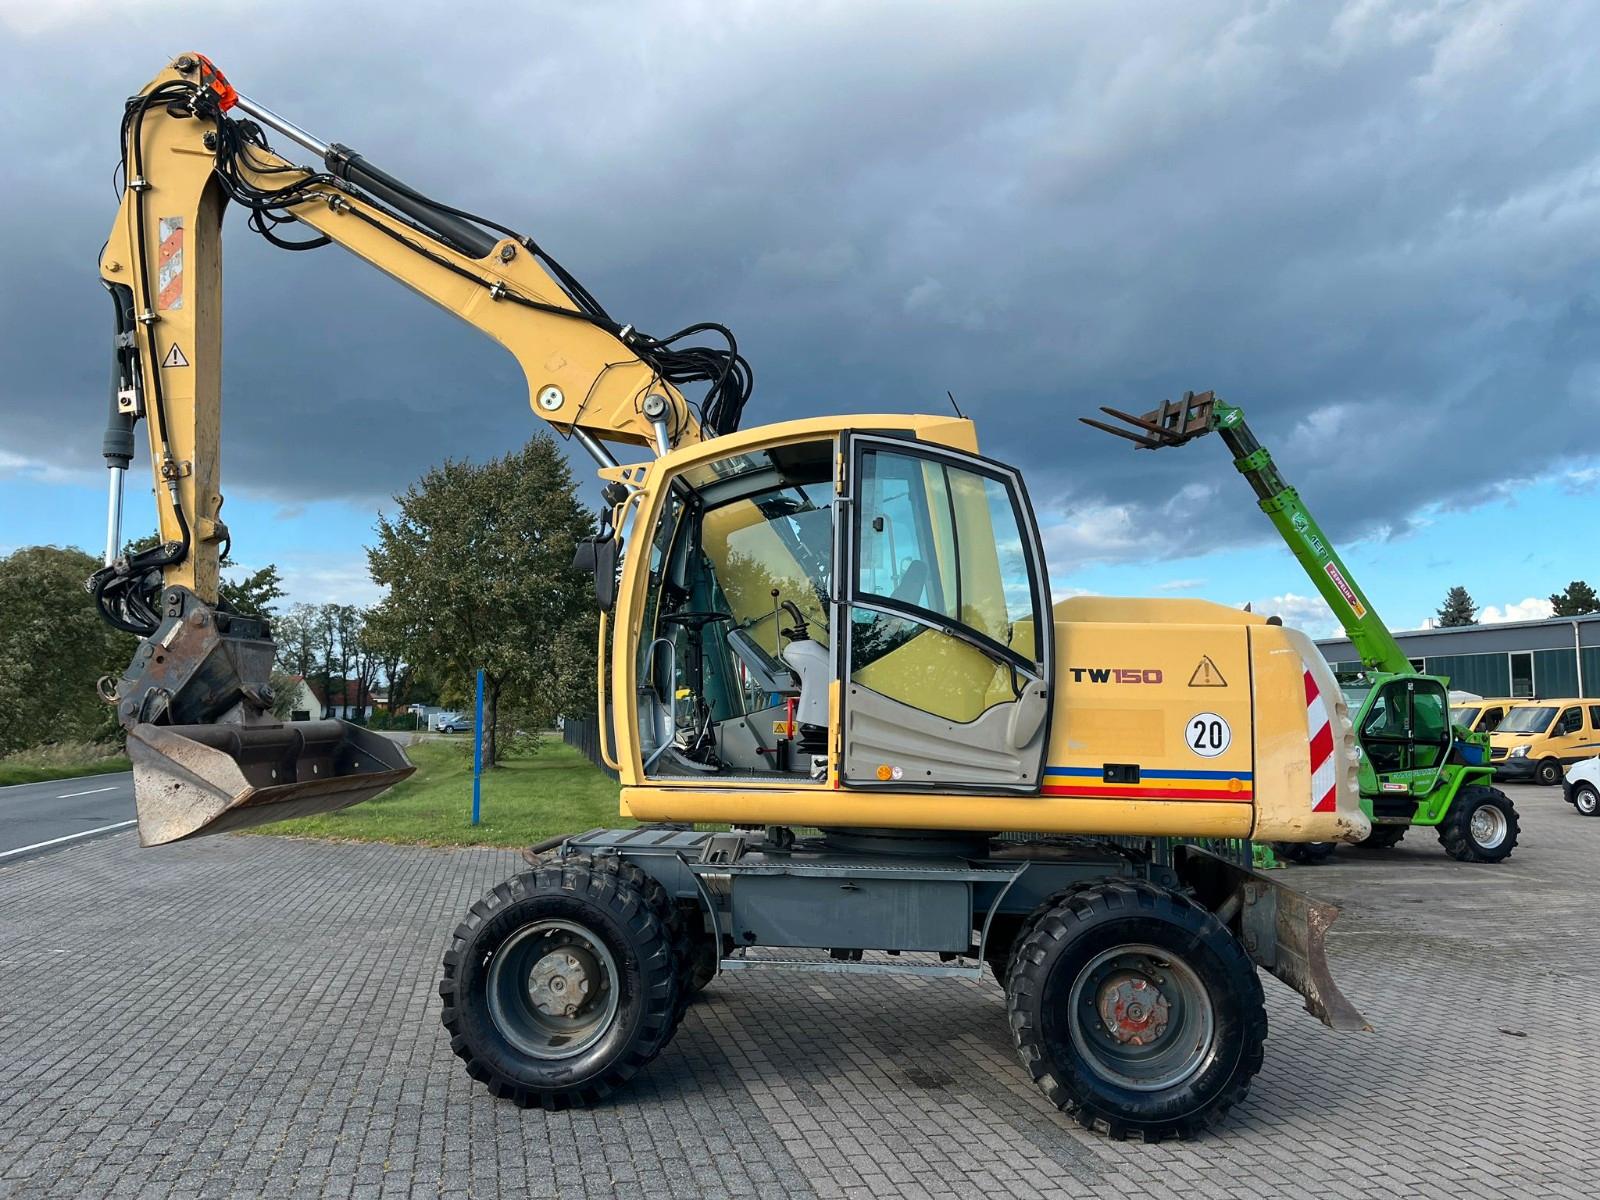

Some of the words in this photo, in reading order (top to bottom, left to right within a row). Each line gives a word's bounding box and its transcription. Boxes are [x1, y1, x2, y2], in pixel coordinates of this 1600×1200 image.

[1329, 569, 1352, 599] ZEPPELIN
[1069, 668, 1163, 684] TW150
[1193, 720, 1223, 749] 20
